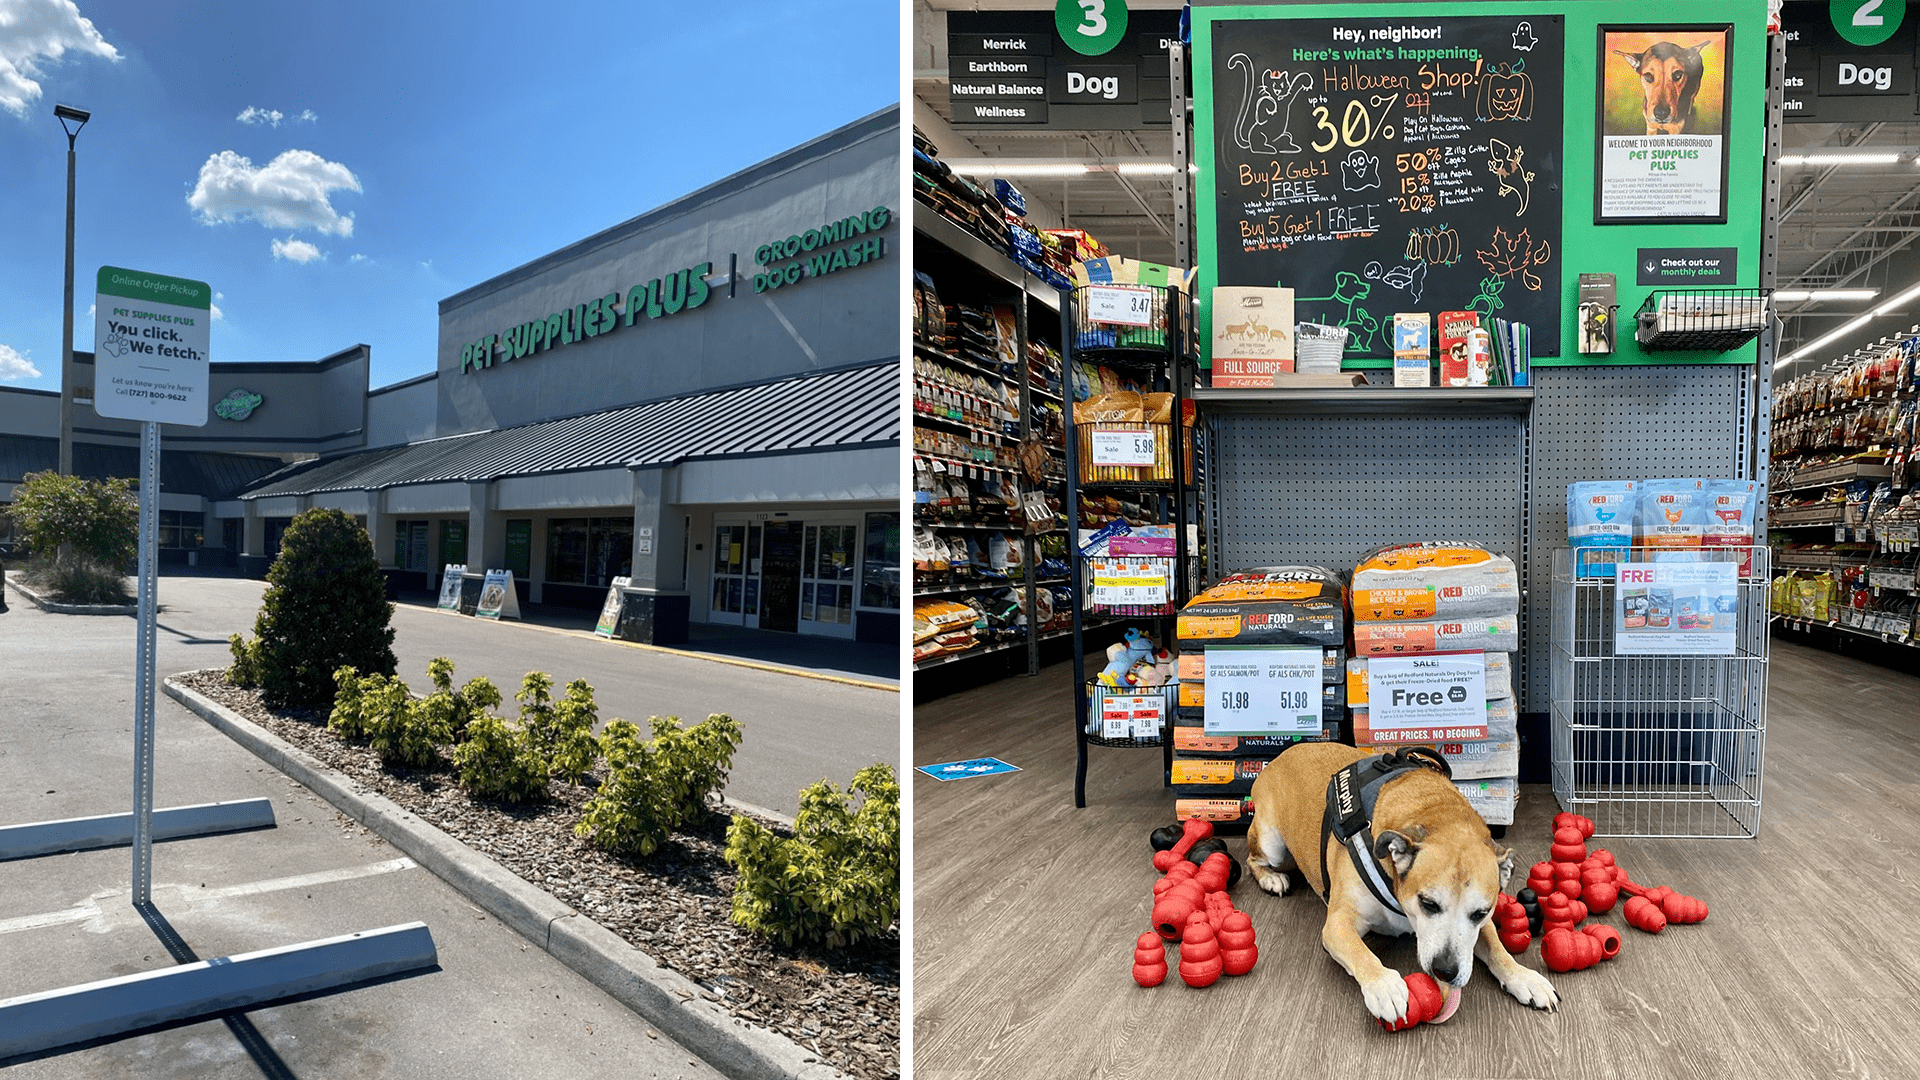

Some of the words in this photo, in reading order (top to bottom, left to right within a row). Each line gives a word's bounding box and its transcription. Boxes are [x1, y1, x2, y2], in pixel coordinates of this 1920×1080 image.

[1076, 0, 1107, 37] 3
[1333, 27, 1365, 43] Hey,
[1369, 25, 1442, 41] neighbor!
[983, 38, 1027, 50] Merrick
[1292, 48, 1340, 61] Here's
[1343, 47, 1395, 61] what's
[1398, 47, 1483, 63] happening.
[968, 61, 1028, 73] Earthborn
[1323, 66, 1411, 92] Halloween
[1418, 58, 1483, 98] Shop!
[1838, 63, 1892, 90] Dog
[952, 83, 996, 95] Natural
[998, 83, 1044, 95] Balance
[1066, 72, 1119, 99] Dog
[974, 106, 1026, 117] Wellness
[1311, 92, 1398, 153] 30%
[1403, 116, 1418, 127] Play
[1431, 114, 1464, 123] Halloween
[1608, 139, 1638, 148] WELCOME
[1640, 139, 1648, 148] TO
[1649, 138, 1666, 148] YOUR
[1667, 138, 1713, 148] NEIGHBORHOOD
[1444, 145, 1467, 156] Zilla
[1629, 150, 1648, 160] PET
[1651, 149, 1699, 160] SUPPLIES
[1396, 147, 1442, 173] 50%
[1444, 156, 1466, 169] Cages
[1650, 160, 1677, 171] PLUS
[1239, 163, 1270, 198] Buy
[1271, 160, 1284, 181] 2
[1286, 161, 1319, 180] Get
[1320, 159, 1330, 176] 1
[1401, 173, 1431, 194] 15%
[1272, 180, 1318, 199] FREE
[1398, 194, 1437, 213] 20%
[1328, 203, 1381, 231] FREE
[1239, 220, 1266, 244] Buy
[1268, 215, 1281, 235] 5
[1284, 214, 1314, 236] Get
[1315, 209, 1322, 231] 1
[753, 205, 892, 267] GROOMING
[1281, 235, 1294, 246] Dog
[752, 261, 804, 294] DOG
[806, 236, 885, 279] WASH
[1661, 258, 1687, 267] Check
[1688, 259, 1703, 267] out
[1705, 259, 1720, 267] our
[1661, 267, 1697, 278] monthly
[1698, 267, 1721, 276] deals
[111, 274, 141, 288] Online
[142, 279, 169, 292] Order
[169, 284, 199, 298] Pickup
[1131, 297, 1150, 313] 3.47
[113, 307, 130, 318] PET
[131, 310, 172, 323] SUPPLIES
[173, 316, 195, 326] PLUS
[459, 333, 499, 376] PET
[500, 291, 621, 364] SUPPLIES
[624, 261, 713, 328] PLUS
[107, 320, 138, 337] You
[142, 326, 184, 343] click.
[129, 340, 154, 354] We
[1223, 361, 1244, 374] FULL
[1246, 361, 1281, 374] SOURCE
[112, 376, 123, 385] Let
[124, 378, 133, 386] us
[134, 379, 153, 388] know
[153, 382, 176, 392] you're
[115, 388, 129, 396] Call
[149, 391, 187, 402] 800-9622
[1134, 439, 1154, 454] 5.98
[1660, 494, 1692, 504] REDFORD
[1717, 495, 1746, 505] REDFORD
[1369, 589, 1397, 597] CHICKEN
[1397, 589, 1403, 597] &
[1443, 585, 1487, 598] REDFORD
[1384, 595, 1408, 603] RECIPE
[1249, 613, 1295, 624] REDFORD
[1248, 623, 1287, 631] NATURALS
[1443, 622, 1486, 635] REDFORD
[1210, 669, 1217, 678] GF
[1217, 669, 1227, 678] ALS
[1227, 669, 1260, 678] SALMON/POT
[1268, 669, 1276, 678] GF
[1277, 669, 1288, 678] ALS
[1289, 669, 1316, 678] CHK/POT
[1222, 691, 1249, 710] 51.98
[1281, 691, 1308, 710] 51.98
[1392, 689, 1444, 707] Free
[1374, 732, 1398, 741] GREAT
[1400, 730, 1431, 740] PRICES.
[1432, 730, 1444, 739] NO
[1446, 728, 1483, 739] BEGGING.
[1444, 744, 1487, 755] REDFORD
[1339, 769, 1353, 815] Murphy
[1459, 786, 1483, 798] FORD
